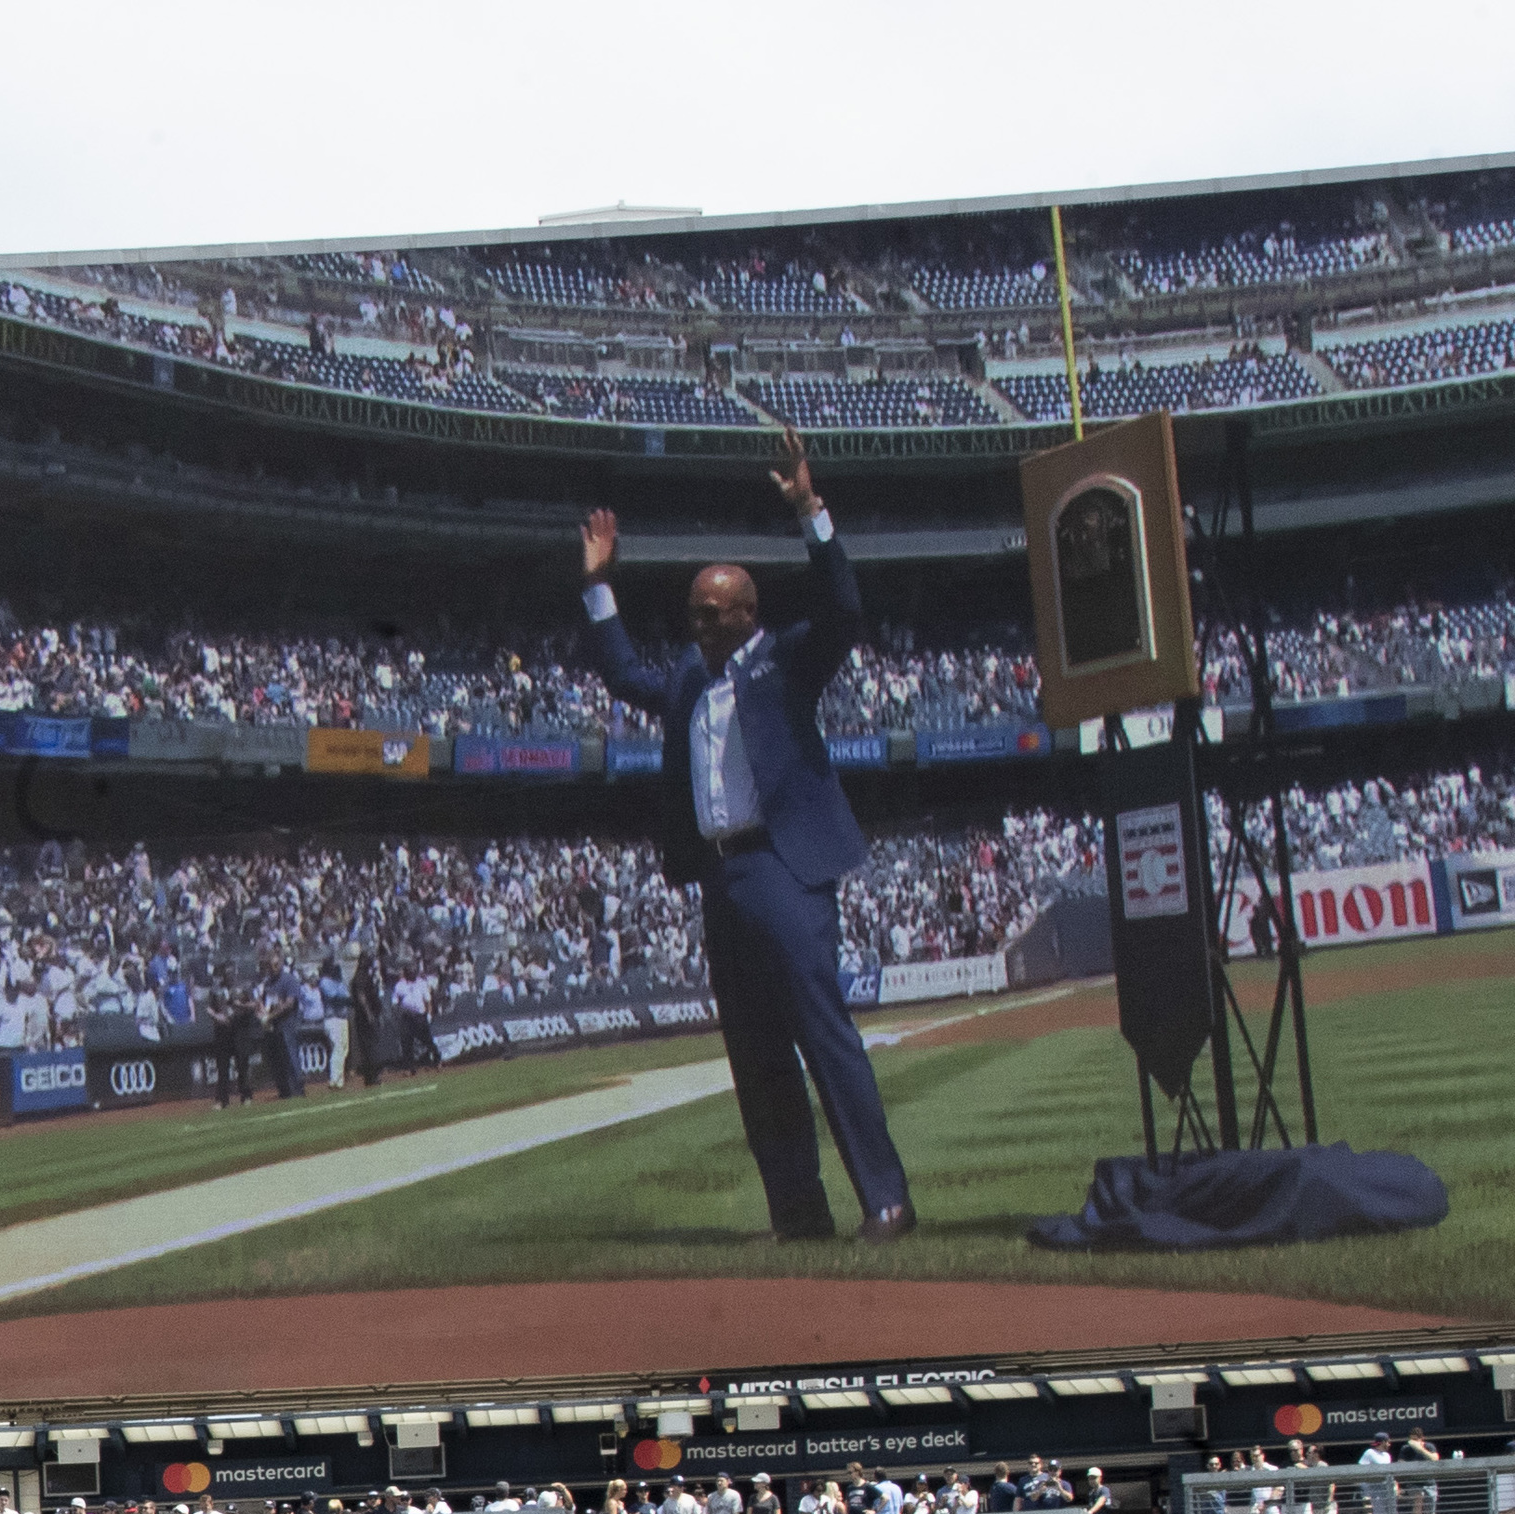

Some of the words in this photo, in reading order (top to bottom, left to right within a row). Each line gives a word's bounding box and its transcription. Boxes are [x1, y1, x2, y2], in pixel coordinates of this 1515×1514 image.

[20, 1063, 85, 1093] GEICO
[1326, 1402, 1438, 1425] mastercard
[685, 1440, 796, 1459] mastercard
[806, 1435, 880, 1455] batter's
[885, 1437, 918, 1452] eye
[921, 1431, 966, 1447] deck
[216, 1460, 327, 1482] mastercard
